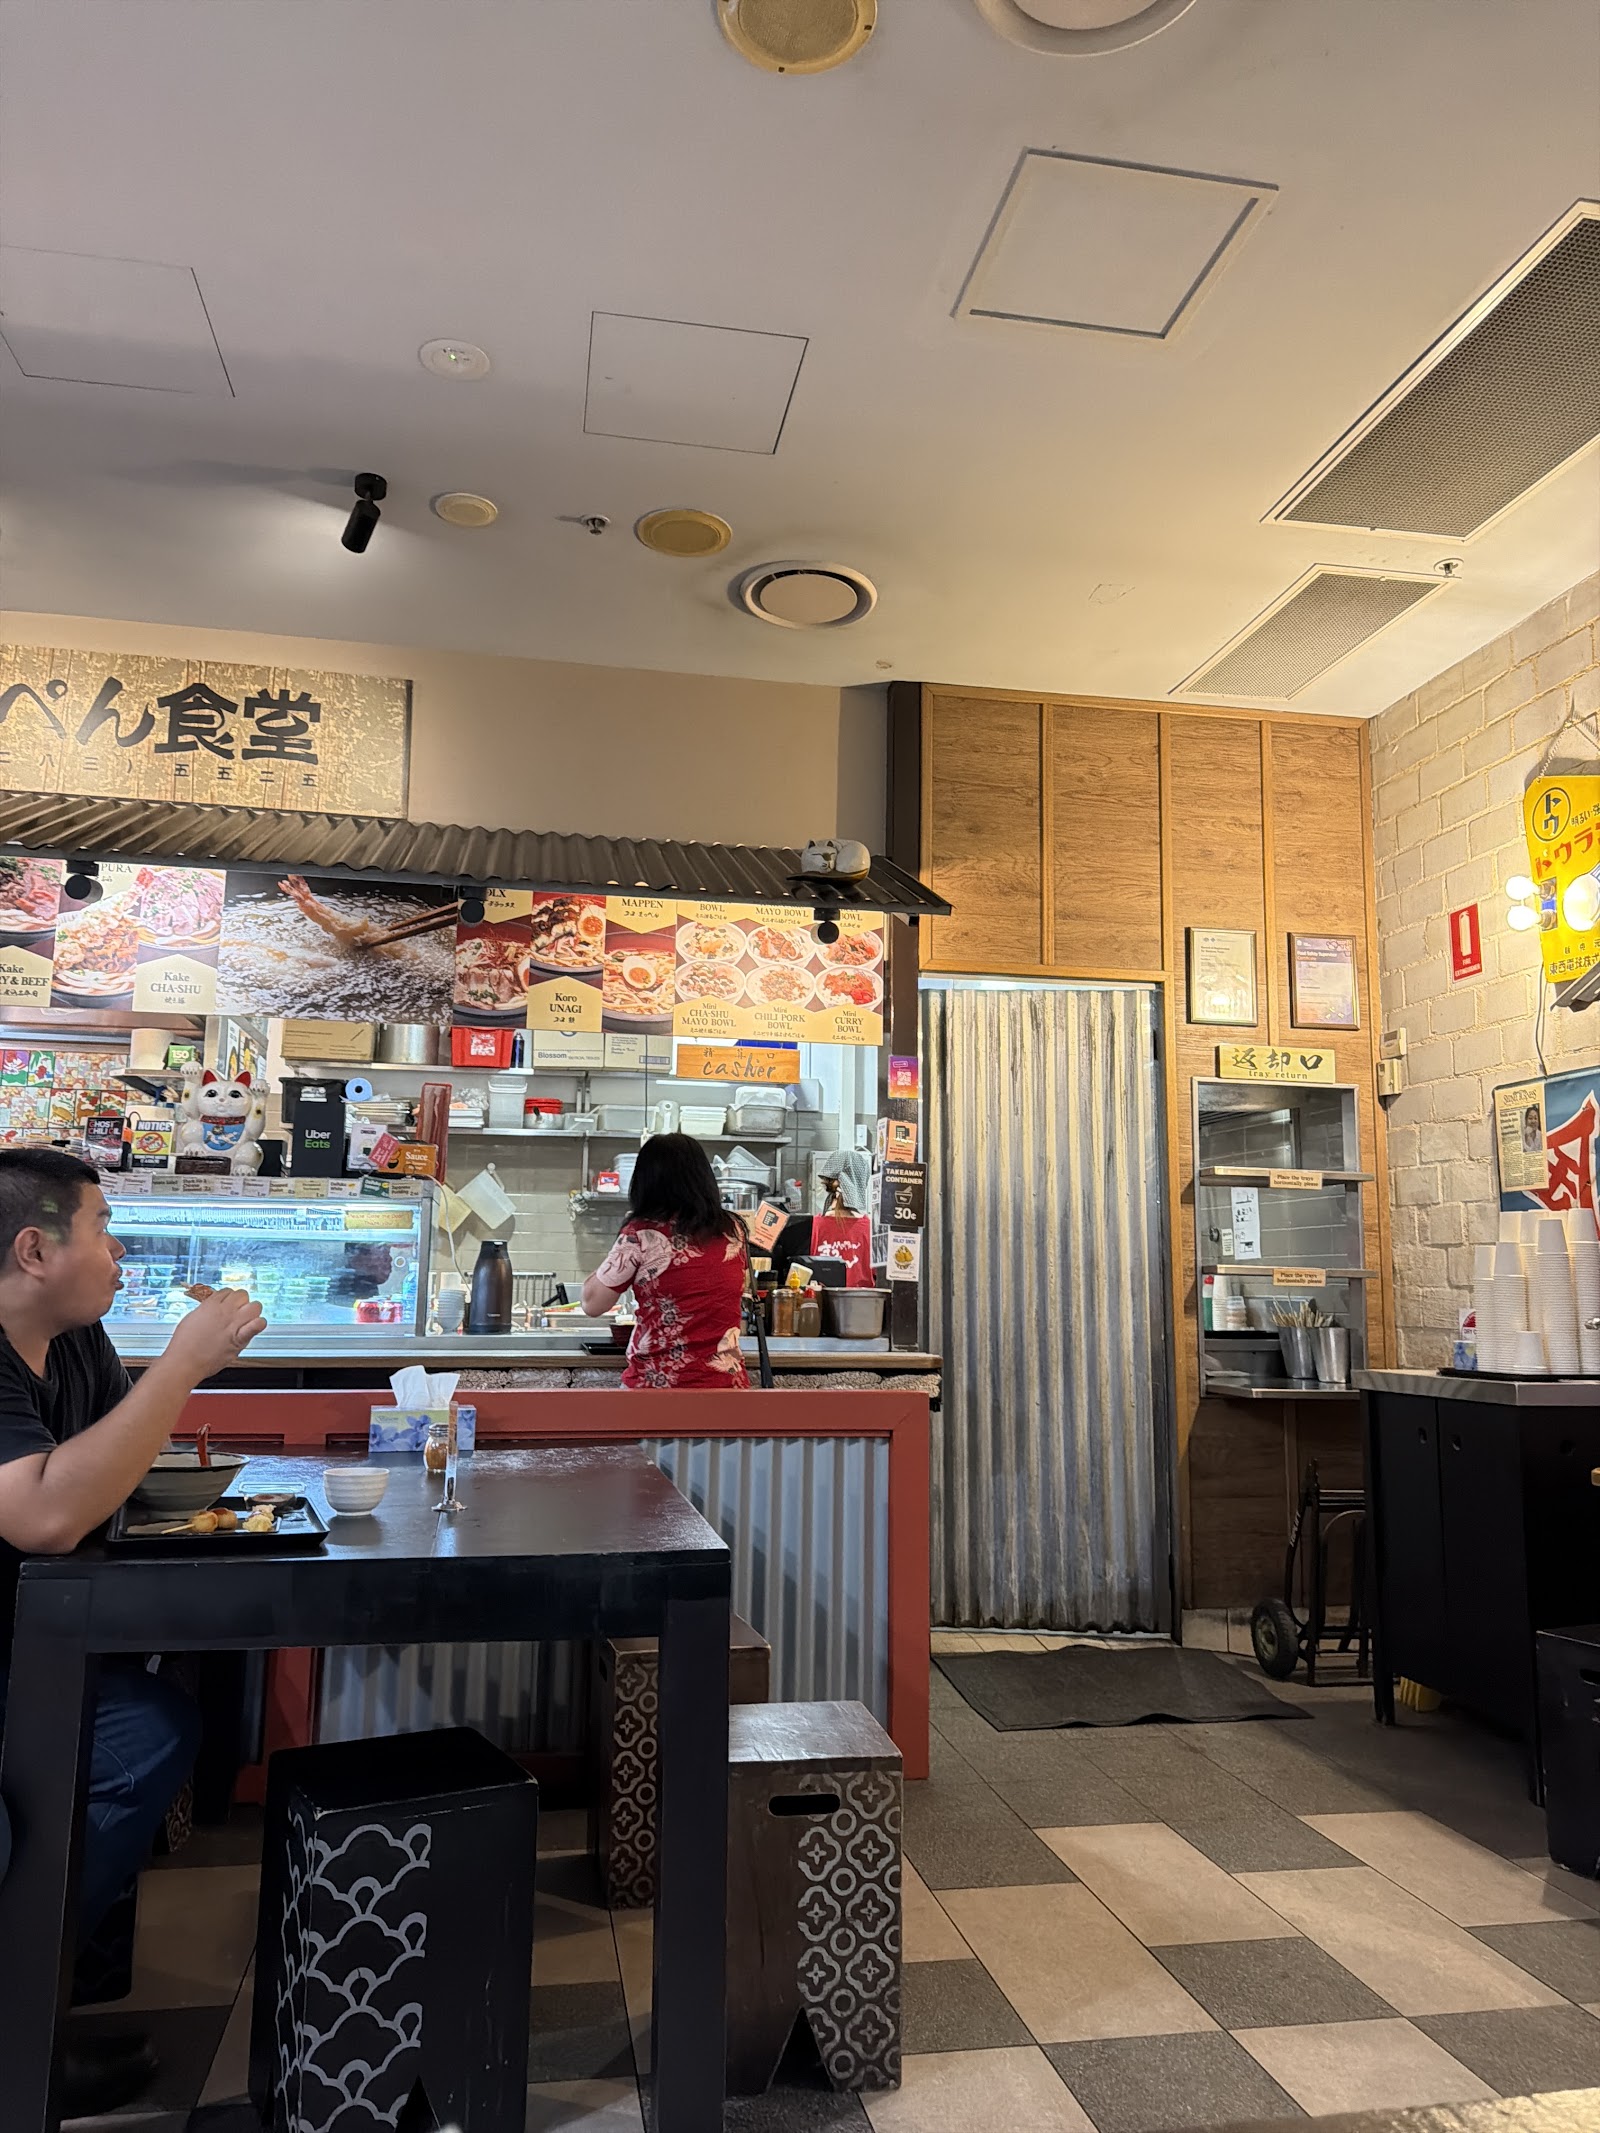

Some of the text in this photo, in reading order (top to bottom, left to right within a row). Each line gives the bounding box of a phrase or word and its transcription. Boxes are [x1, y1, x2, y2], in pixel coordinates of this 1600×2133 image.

[621, 898, 664, 909] MAPPEN
[699, 903, 725, 912] BOWL
[755, 906, 809, 918] MAYO BOWL
[10, 976, 20, 985] &
[21, 976, 50, 986] BEEF
[164, 971, 190, 982] Kake
[150, 983, 202, 995] CHA-SHU
[555, 992, 578, 1003] Koro
[549, 1003, 582, 1014] UNAGI
[689, 1009, 729, 1019] CHA-SHU
[754, 1012, 806, 1023] CHILI PORK
[681, 1017, 736, 1027] MAYO BOWL
[767, 1021, 793, 1030] BOWL
[834, 1016, 864, 1025] CURRY
[837, 1024, 862, 1033] BOWL
[537, 1051, 567, 1059] Blossom
[1231, 1047, 1323, 1072] 返却口
[702, 1053, 777, 1078] cashier
[1249, 1070, 1308, 1080] tray return
[89, 1120, 114, 1128] GHOST
[138, 1121, 171, 1131] NOTICE
[88, 1127, 108, 1135] CHILI
[305, 1129, 331, 1139] Uber
[304, 1139, 331, 1149] Eats
[405, 1151, 429, 1161] Sauce
[886, 1168, 924, 1177] TAKEAWAY
[885, 1176, 923, 1185] CONTAINER
